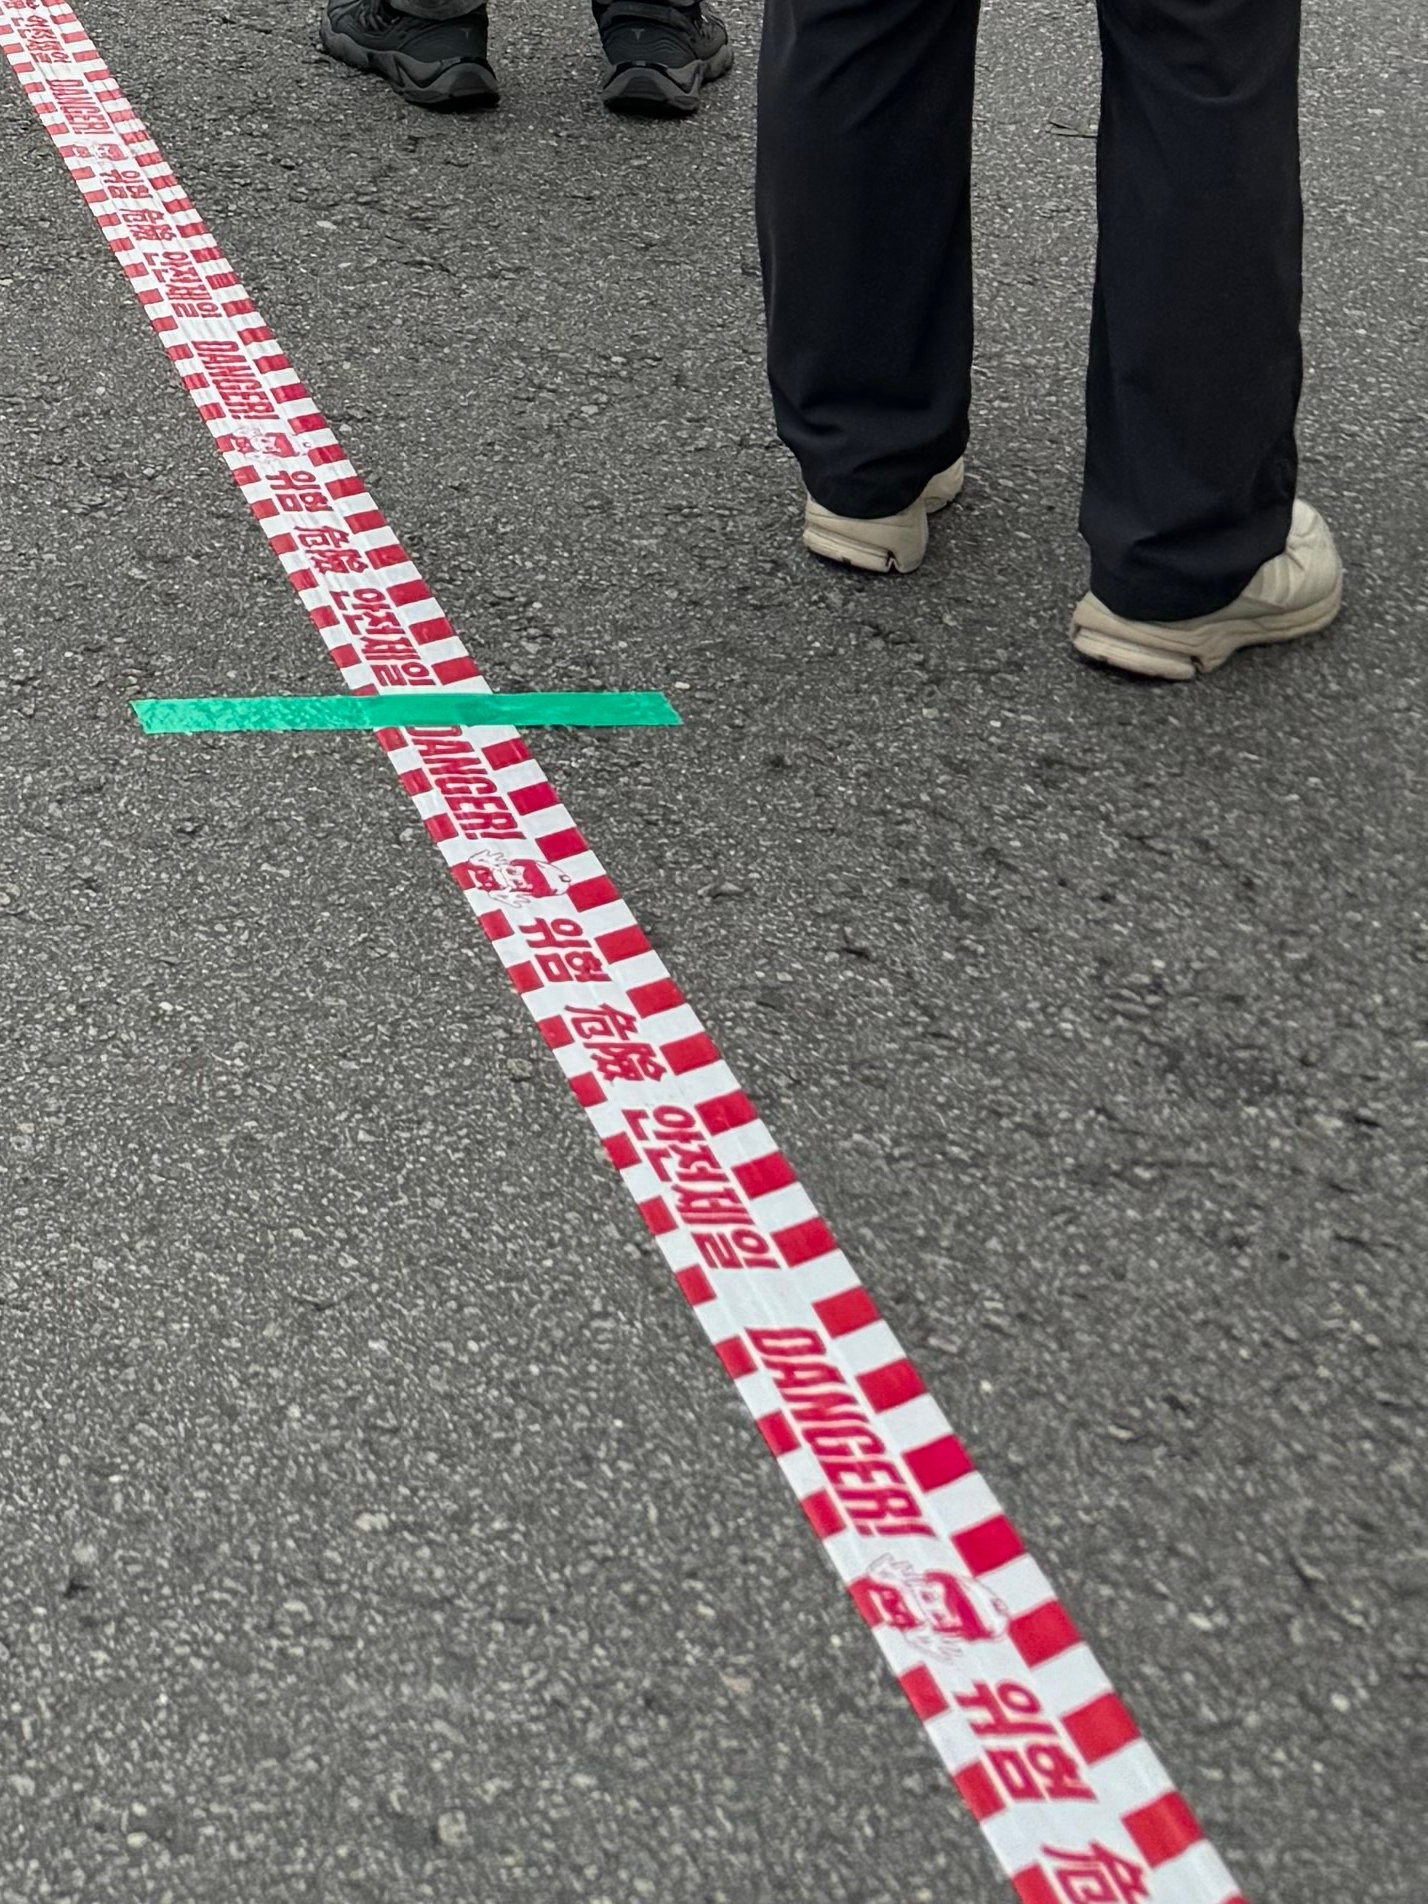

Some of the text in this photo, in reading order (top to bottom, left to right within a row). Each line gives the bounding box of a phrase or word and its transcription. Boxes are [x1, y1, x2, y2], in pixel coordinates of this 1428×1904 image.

[191, 340, 281, 421] DANGER!
[266, 470, 334, 513] 위험
[331, 586, 437, 687] 안전제일
[406, 725, 526, 842] DANGER!
[519, 915, 612, 984] 위험
[622, 1104, 780, 1271] 안전제일
[744, 1326, 937, 1540] DANGER!
[955, 1678, 1100, 1804] 위험
[1041, 1840, 1150, 1904] 危
